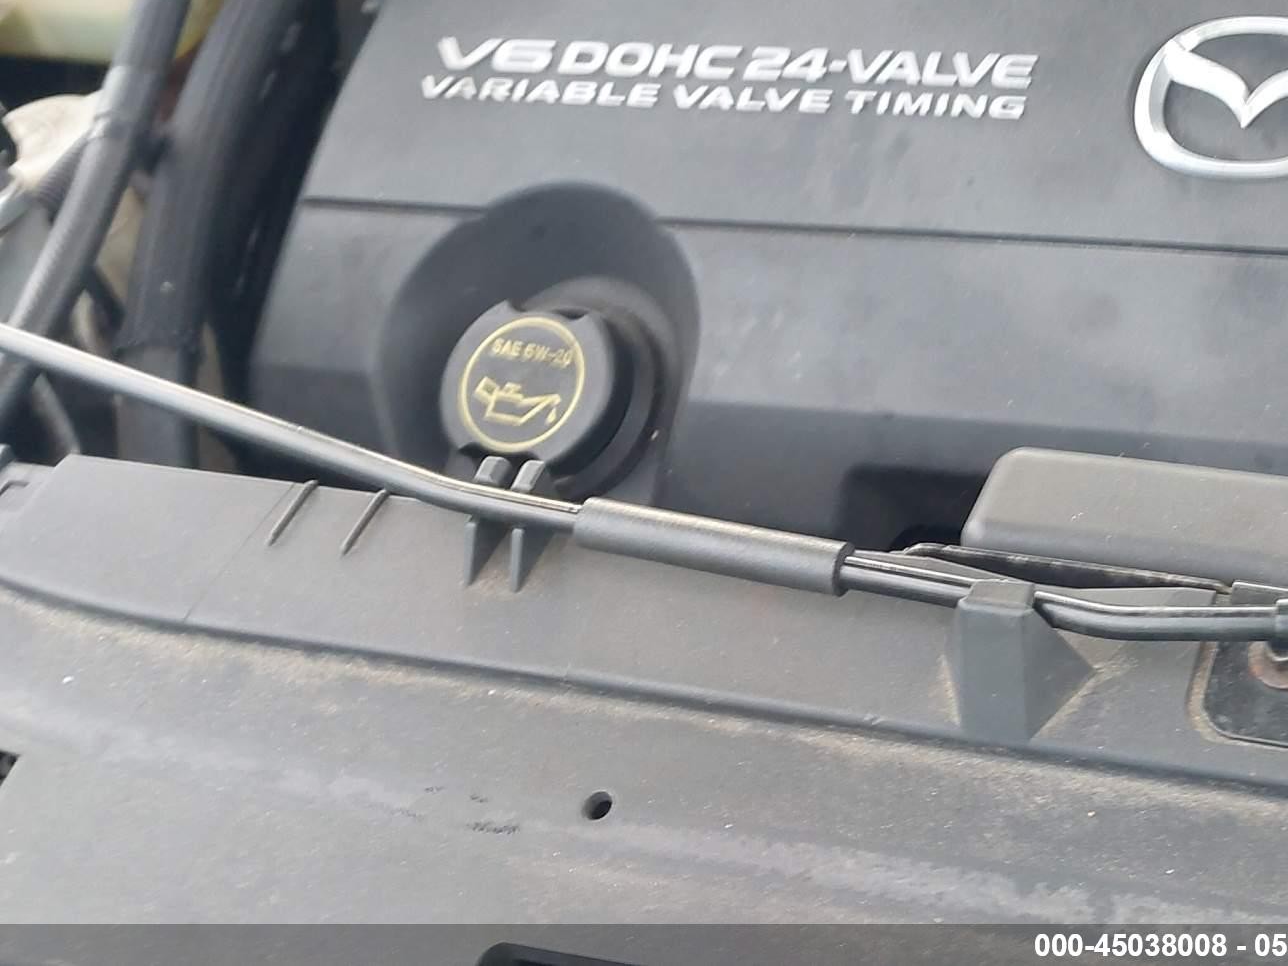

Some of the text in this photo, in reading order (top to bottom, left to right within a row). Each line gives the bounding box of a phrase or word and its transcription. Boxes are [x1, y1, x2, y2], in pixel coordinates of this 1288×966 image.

[437, 36, 1039, 89] V6 DOHC 24-VALVE
[421, 75, 1028, 120] VARIABLE VALVE TIMING
[491, 337, 524, 357] SAE
